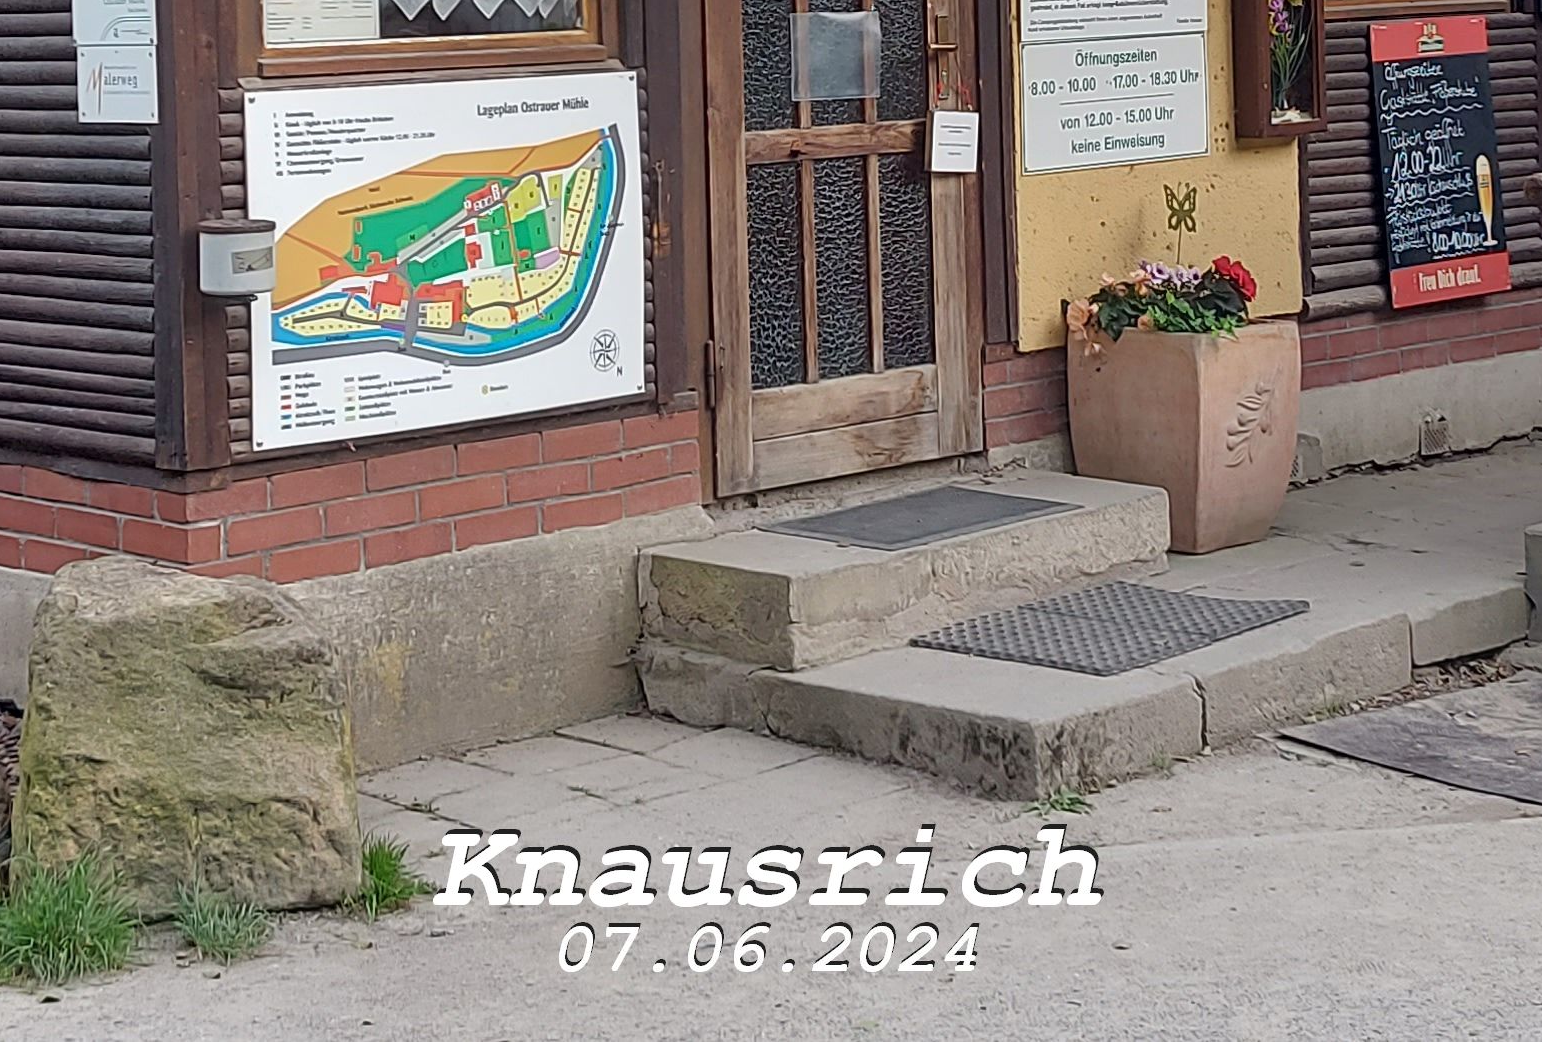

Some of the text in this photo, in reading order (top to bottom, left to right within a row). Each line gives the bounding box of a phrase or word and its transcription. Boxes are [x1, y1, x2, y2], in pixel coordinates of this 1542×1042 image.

[1074, 48, 1158, 67] Öffnungszeiten
[1030, 80, 1056, 96] 8.00
[1067, 77, 1097, 93] 10.00
[1112, 73, 1139, 89] 17.00
[1149, 70, 1177, 86] 18.30
[1180, 69, 1200, 83] Uhr
[476, 96, 590, 119] Lageplan Ostrauer Mühle
[1060, 117, 1081, 130] von
[1084, 111, 1113, 127] 12.00
[1123, 107, 1152, 123] 15.00
[1154, 106, 1175, 121] Uhr
[1071, 133, 1165, 154] keine Einweisung
[617, 366, 623, 376] N
